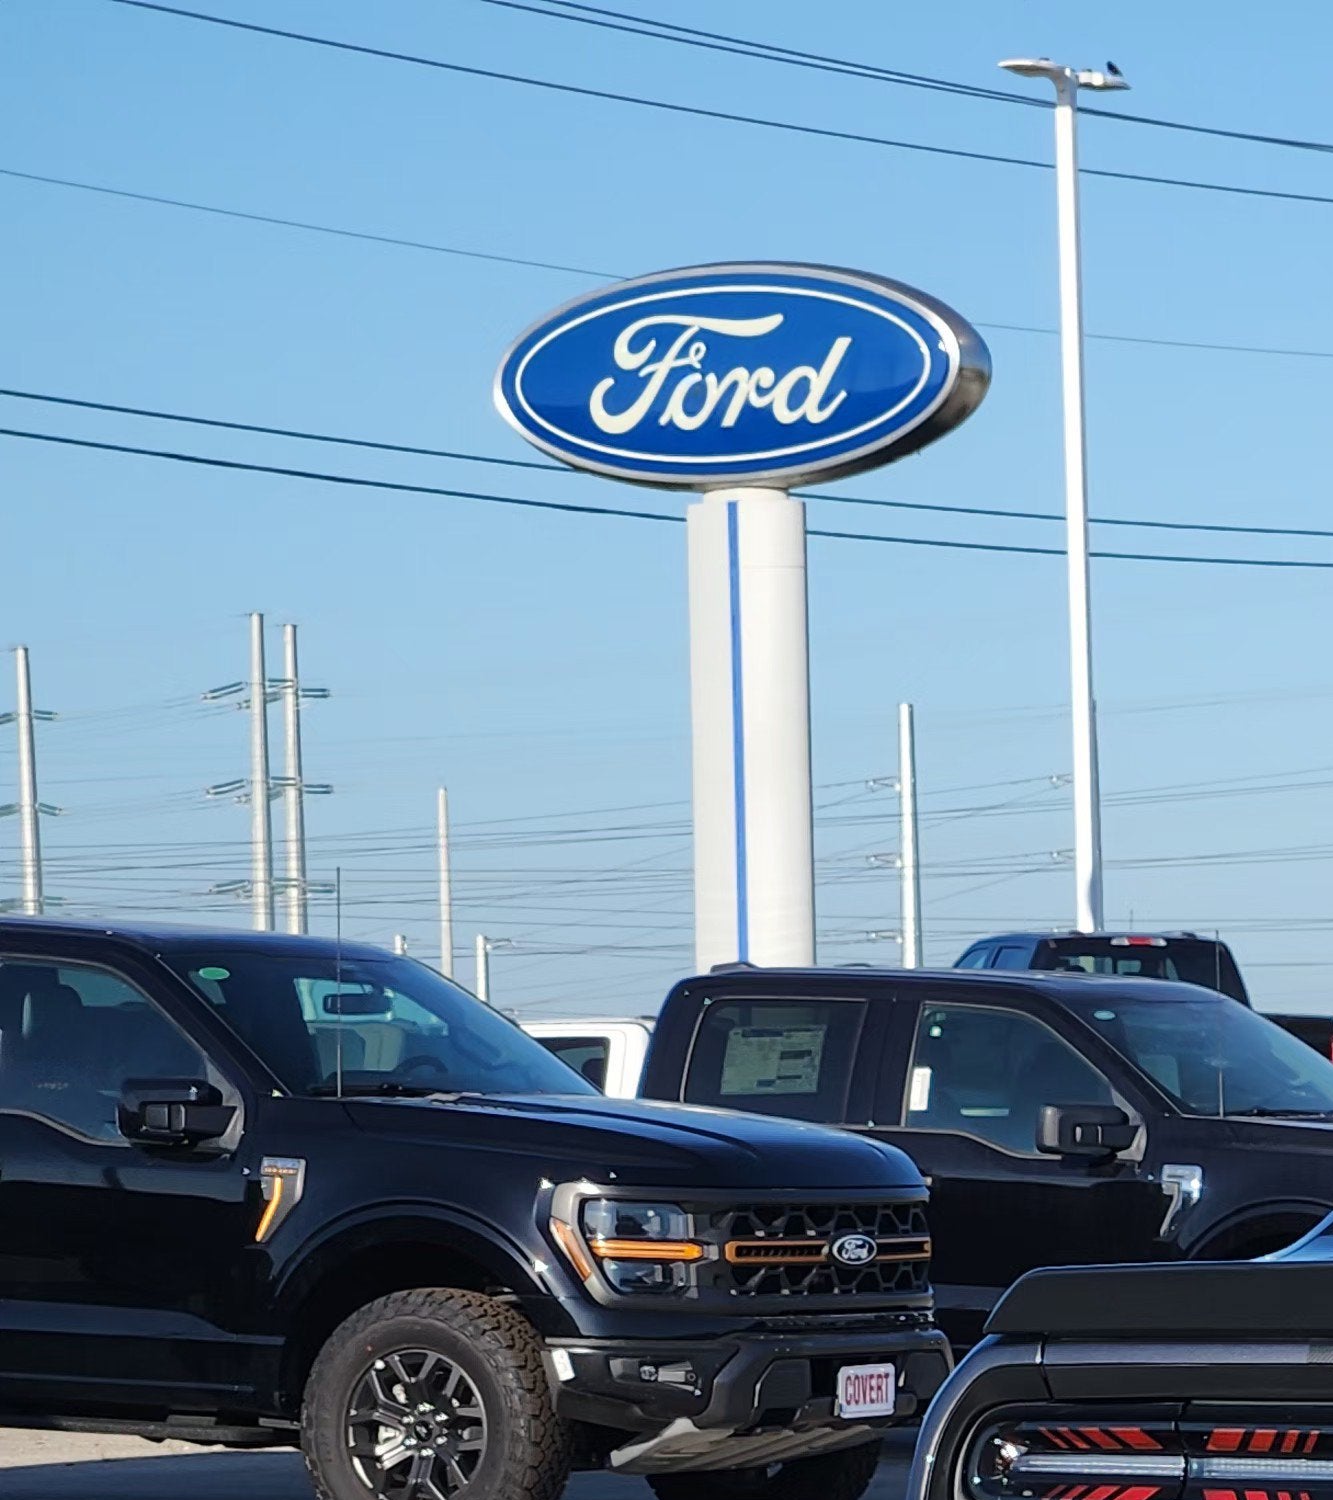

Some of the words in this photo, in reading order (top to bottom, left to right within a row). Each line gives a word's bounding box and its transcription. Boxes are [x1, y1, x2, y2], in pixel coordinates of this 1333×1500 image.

[589, 313, 853, 435] Ford
[841, 1239, 869, 1260] Ford
[845, 1373, 890, 1406] COVERT
